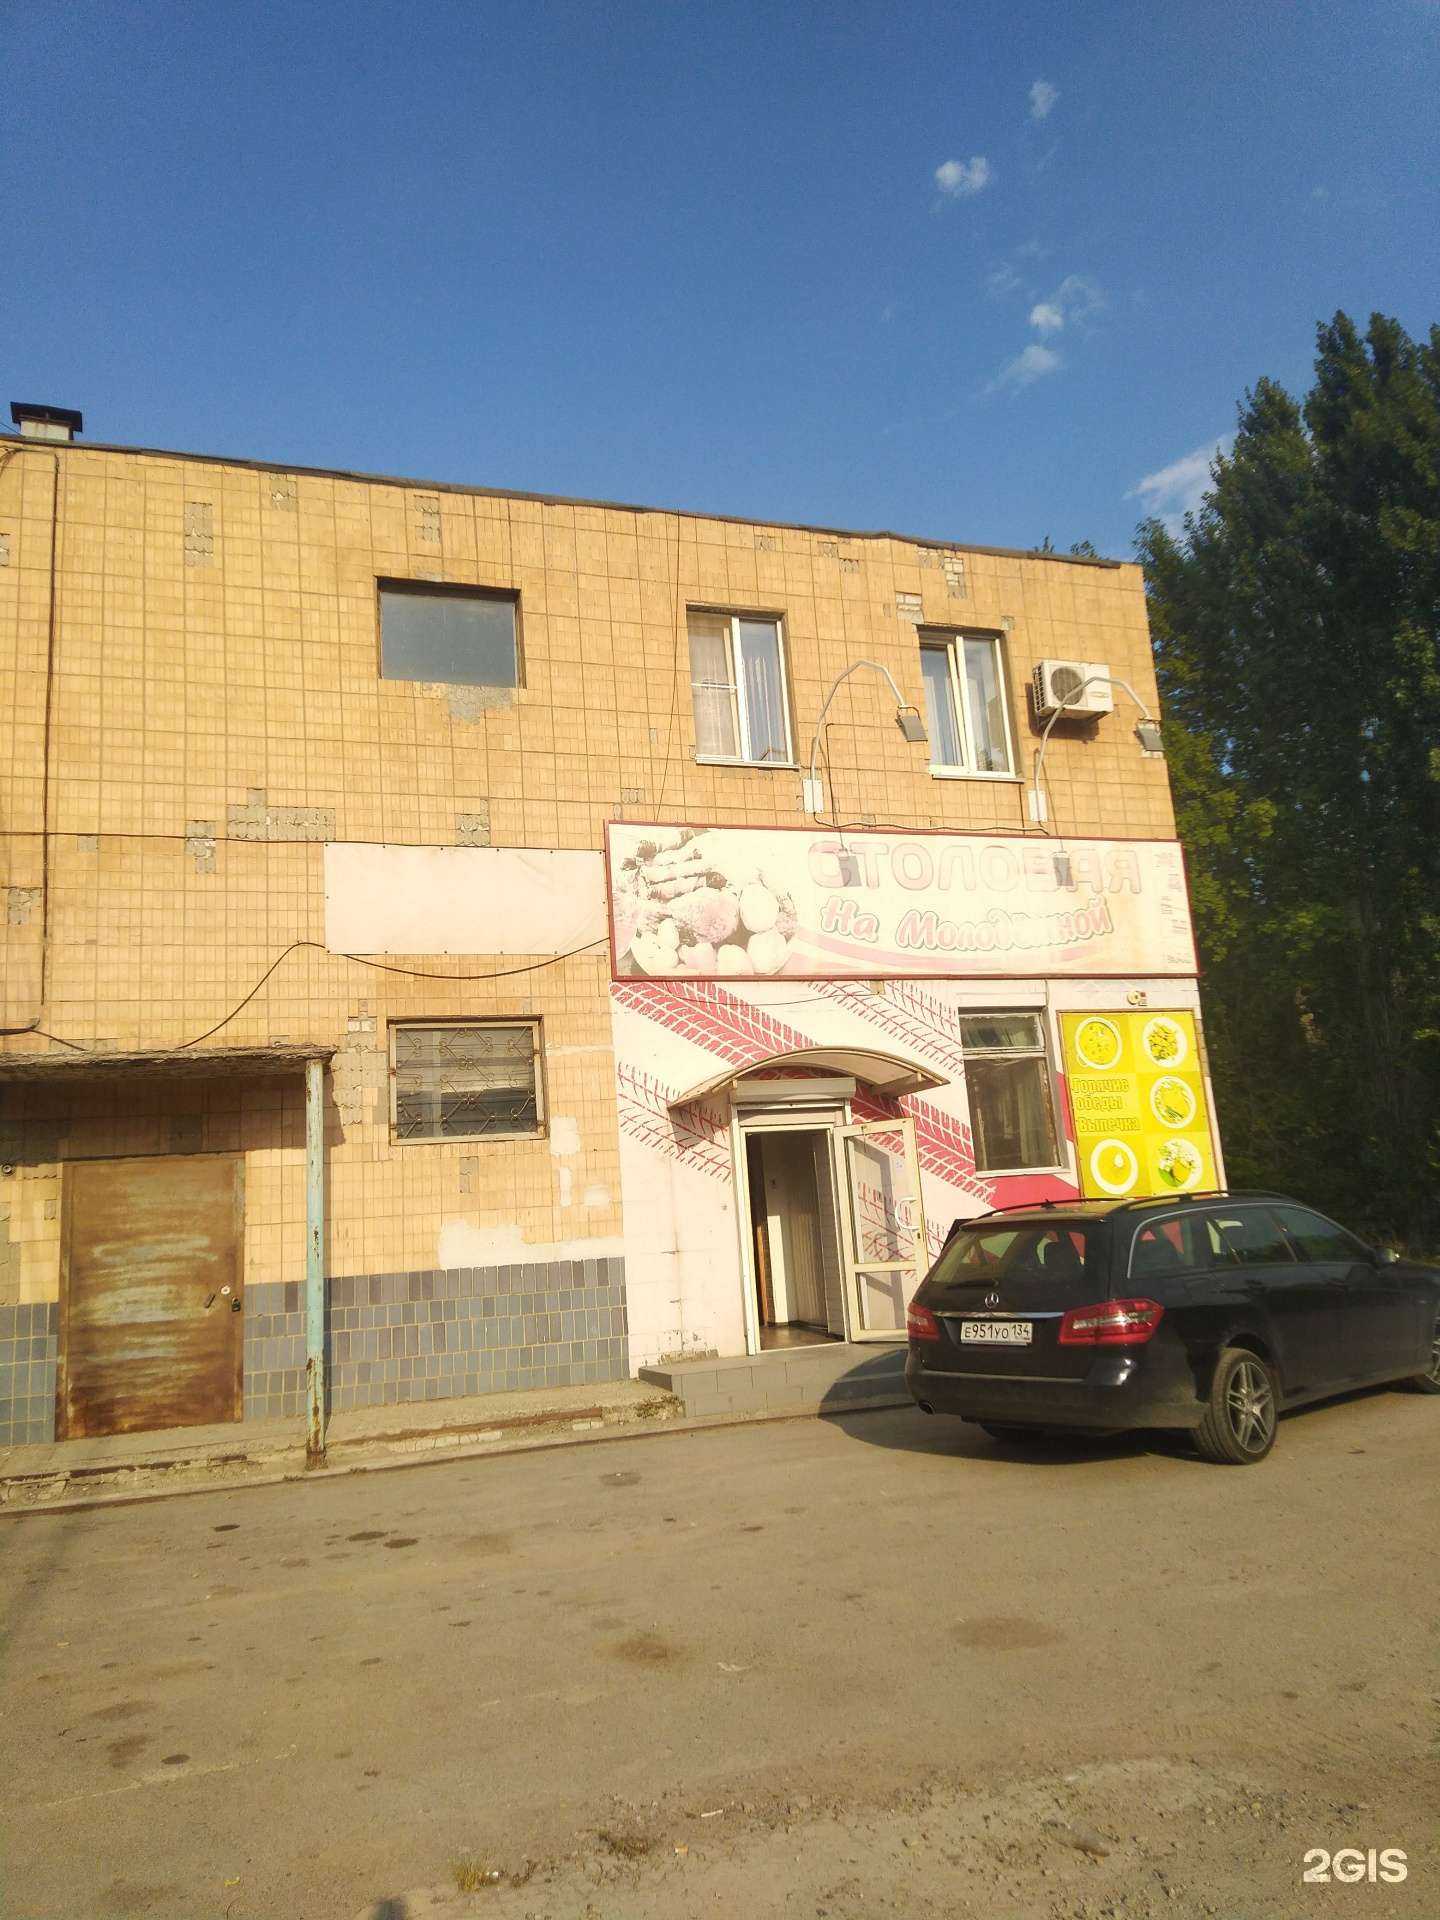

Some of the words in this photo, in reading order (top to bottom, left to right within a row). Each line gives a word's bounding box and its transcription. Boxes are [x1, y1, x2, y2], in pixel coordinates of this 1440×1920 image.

[809, 841, 1142, 893] СТОЛОВАЯ
[821, 896, 879, 942] На
[897, 895, 1113, 951] Молодной
